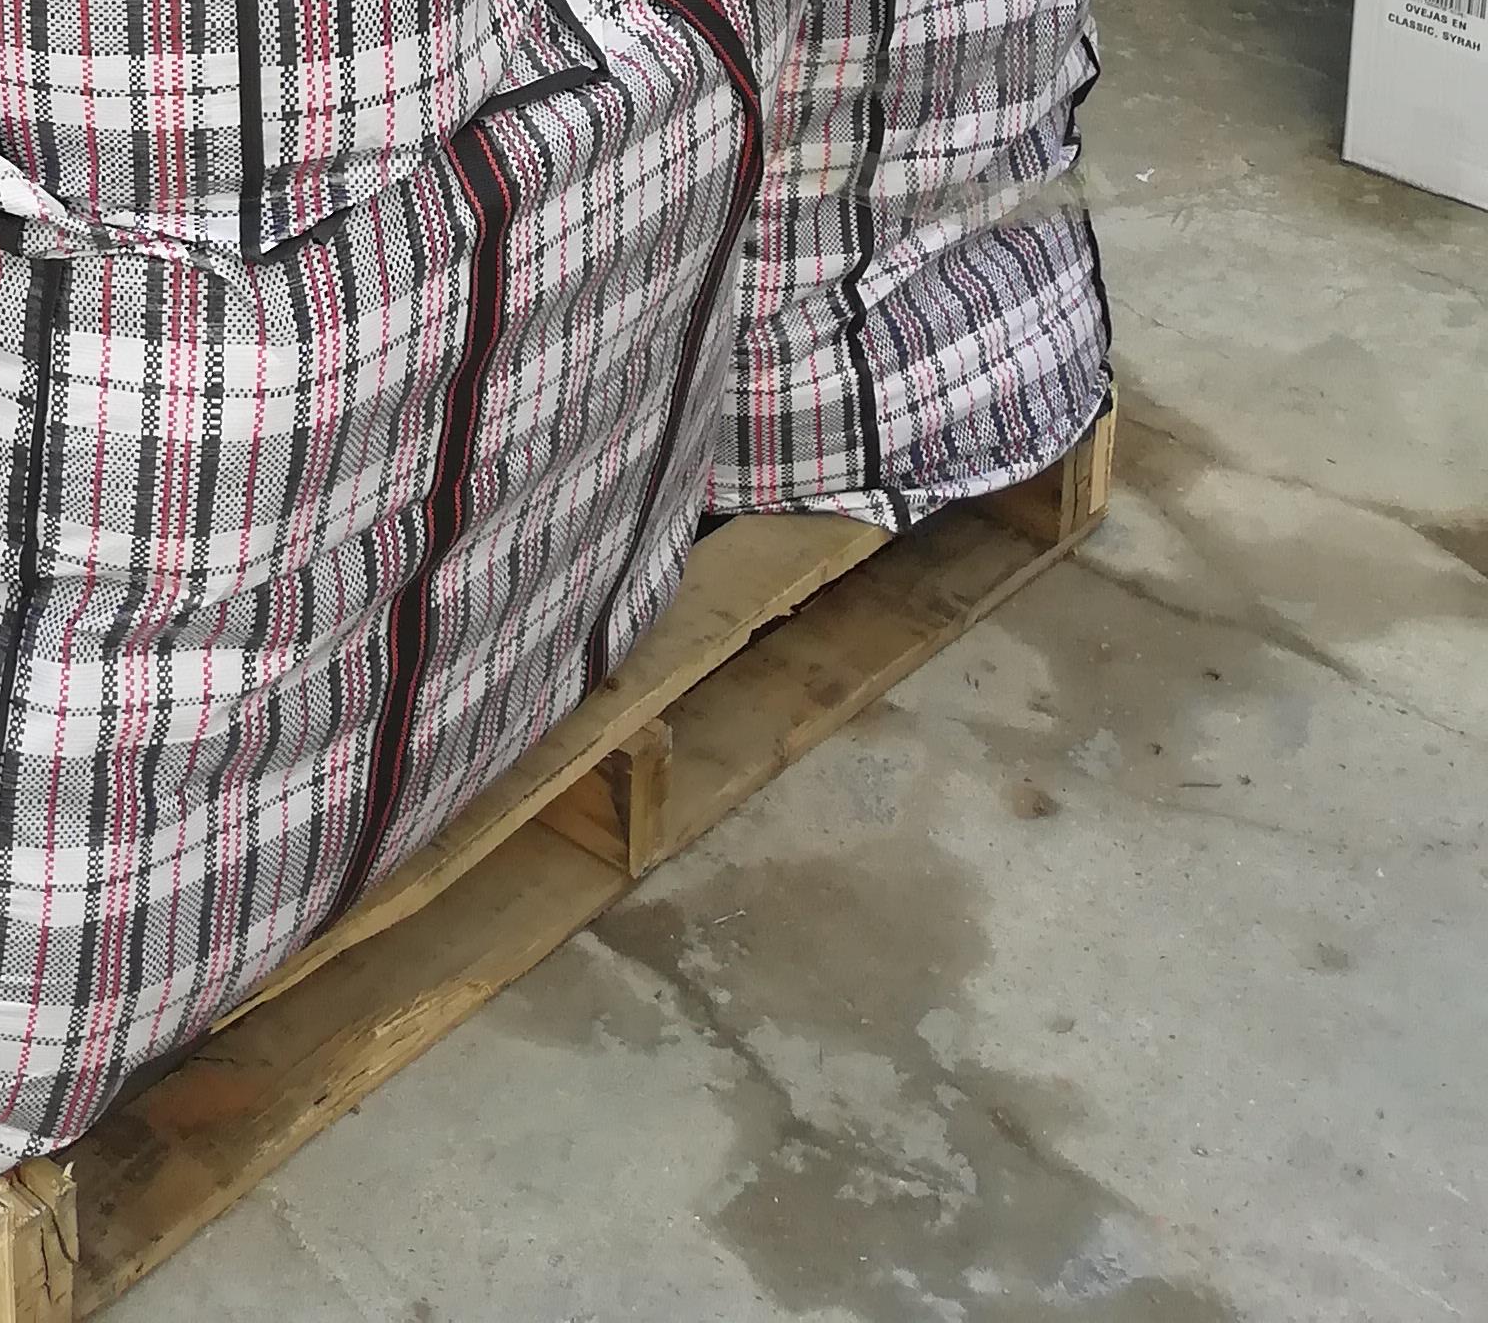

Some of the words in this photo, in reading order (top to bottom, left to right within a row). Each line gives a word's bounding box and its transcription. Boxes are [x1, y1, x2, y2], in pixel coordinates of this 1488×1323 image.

[1405, 3, 1448, 24] OVEJAS
[1452, 19, 1467, 30] EN
[1442, 32, 1481, 52] SYRAH
